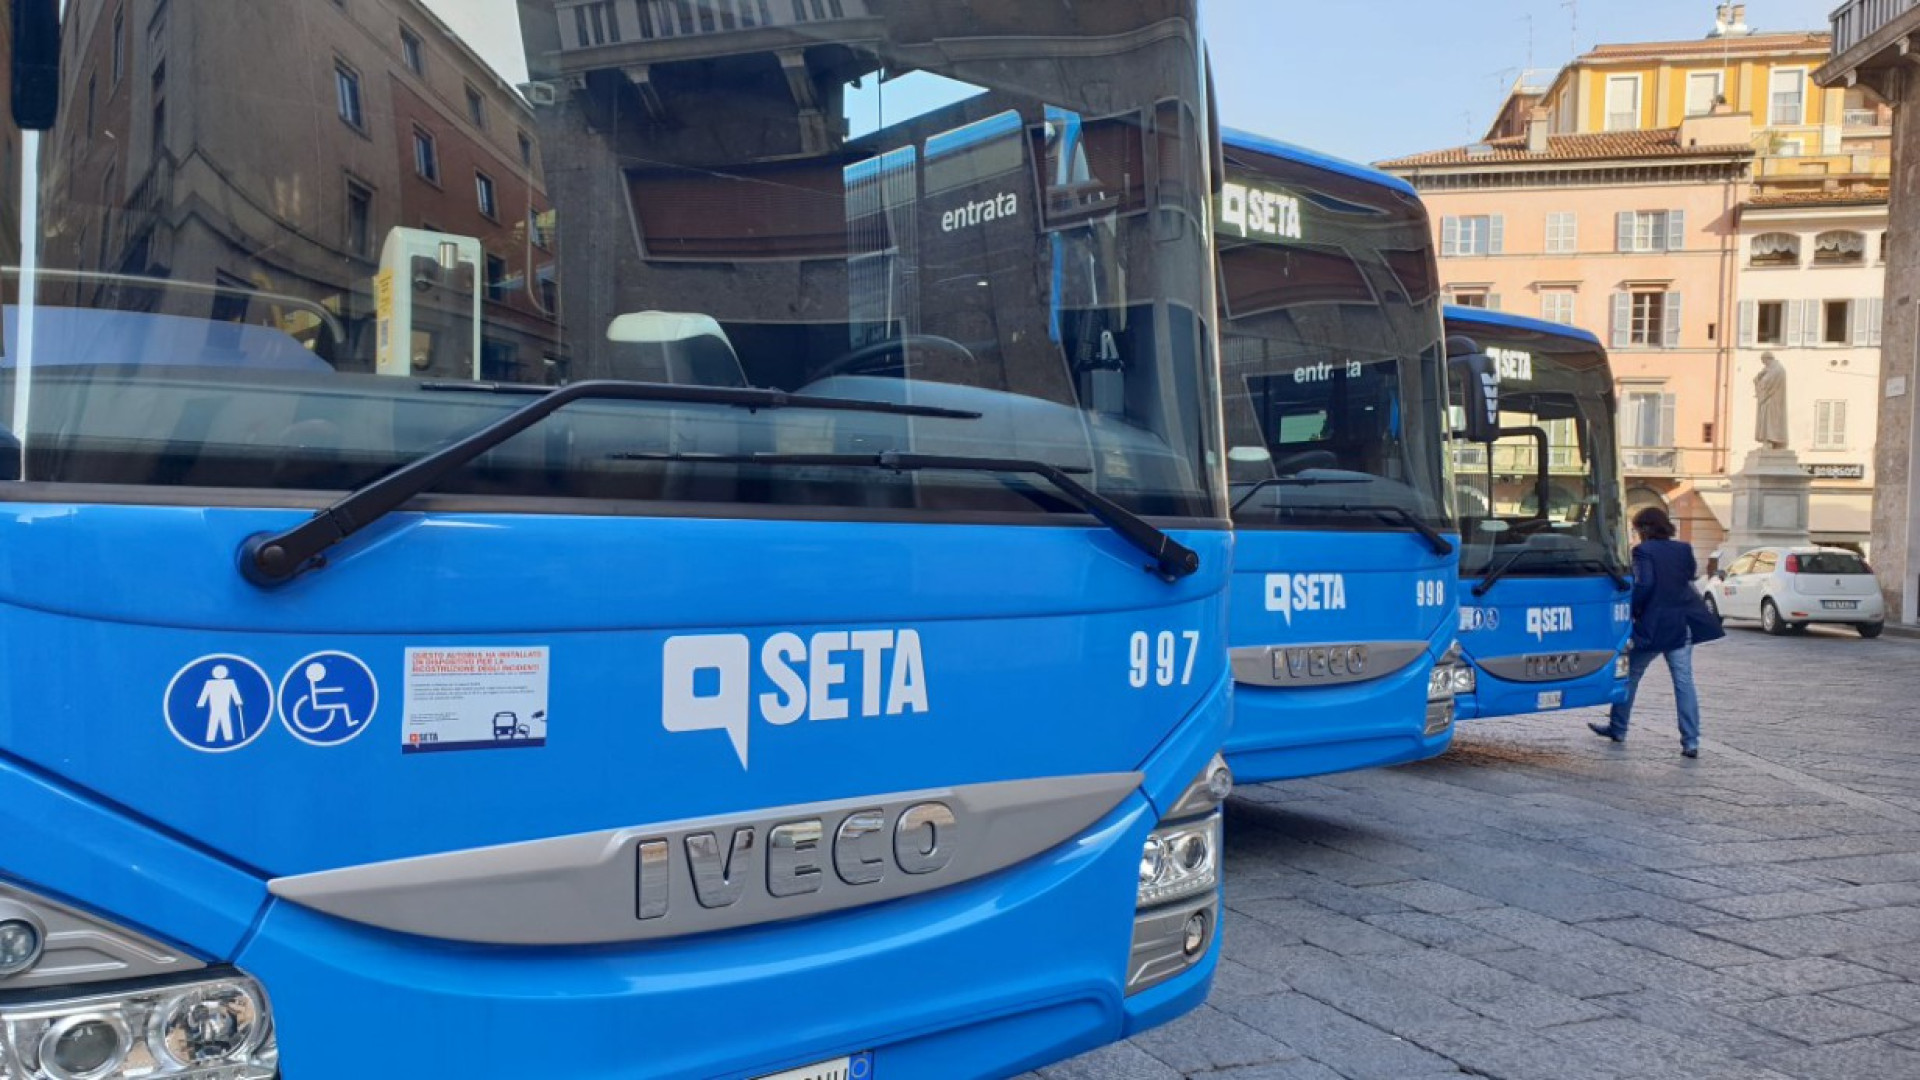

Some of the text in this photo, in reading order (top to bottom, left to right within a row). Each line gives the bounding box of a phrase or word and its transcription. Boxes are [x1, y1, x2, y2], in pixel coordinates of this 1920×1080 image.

[942, 192, 1017, 232] entrata
[1249, 189, 1302, 239] SETA
[1294, 358, 1362, 384] entrta
[1501, 349, 1533, 381] SETA
[1292, 573, 1346, 611] SETA
[1416, 580, 1444, 607] 998
[1541, 606, 1573, 632] SETA
[759, 629, 930, 726] SETA
[1129, 630, 1199, 688] 997
[1271, 644, 1368, 681] IVECO
[634, 799, 956, 921] IVECO
